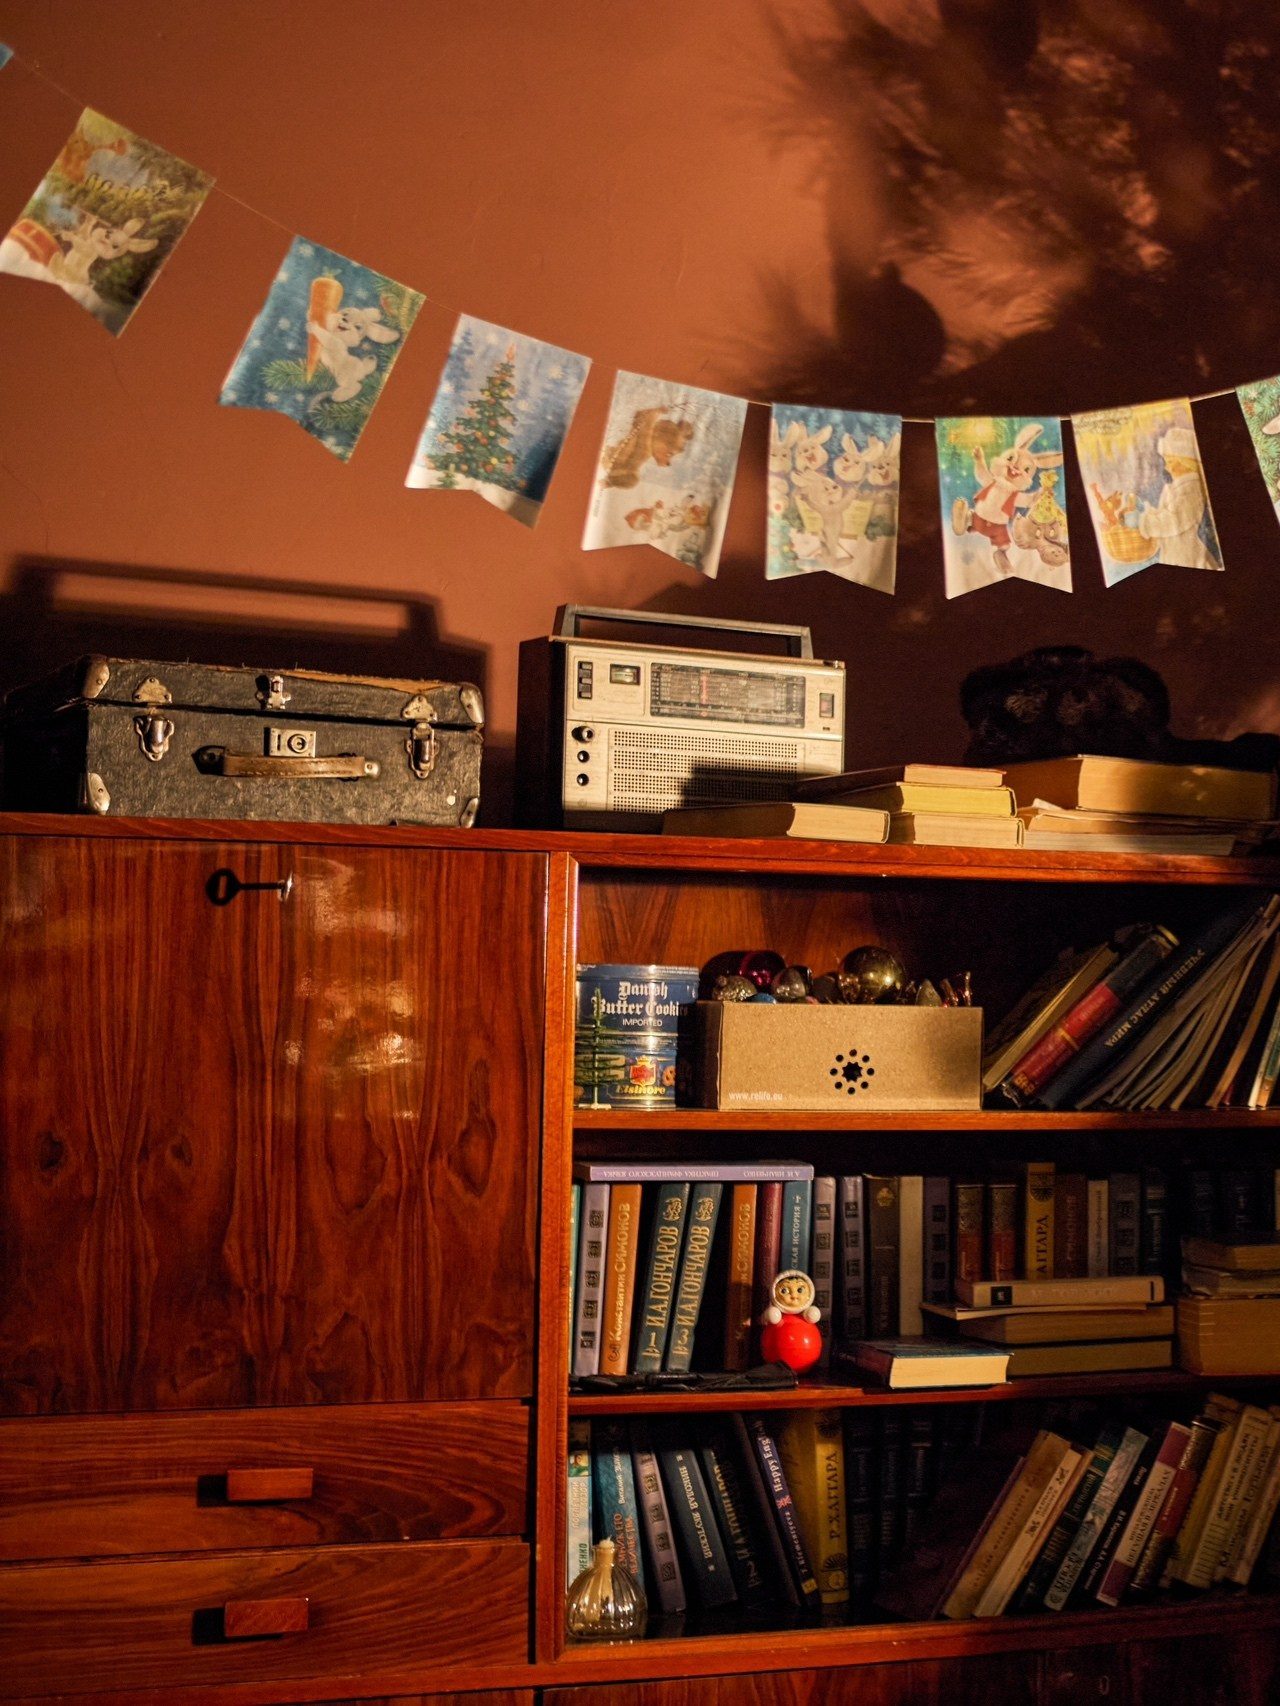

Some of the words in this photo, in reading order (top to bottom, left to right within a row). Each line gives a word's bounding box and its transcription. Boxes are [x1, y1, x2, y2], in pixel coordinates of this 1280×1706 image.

[1158, 946, 1205, 995] УЧЕБНЫЙ
[618, 981, 668, 1000] Danish
[1129, 991, 1161, 1024] АТЛАС
[622, 1018, 663, 1027] IMPORTED
[1103, 1020, 1132, 1049] МИРА
[616, 1085, 666, 1095] Elsinore
[613, 1202, 631, 1272] СИМОНОВ
[736, 1203, 750, 1271] СИМОНОВ
[792, 1206, 800, 1244] ИСТОРИЯ
[643, 1224, 680, 1328] И.А.ГОНЧАРОВ
[674, 1223, 711, 1326] И.А.ГОНЧАРОВ
[608, 1273, 626, 1341] Константин
[649, 1331, 657, 1346] 1
[677, 1327, 689, 1344] 3
[615, 1475, 625, 1503] Виталий
[765, 1456, 786, 1492] Happy
[678, 1465, 698, 1509] НИКОЛАЙ
[691, 1509, 713, 1559] ЯКУТСКИЙ
[825, 1451, 840, 1538] Р.ХАГГАРД
[613, 1513, 622, 1529] ЕГО
[1125, 1521, 1148, 1563] БЕГУЩАЯ
[1145, 1468, 1171, 1514] ЗЕРКАЛАХ
